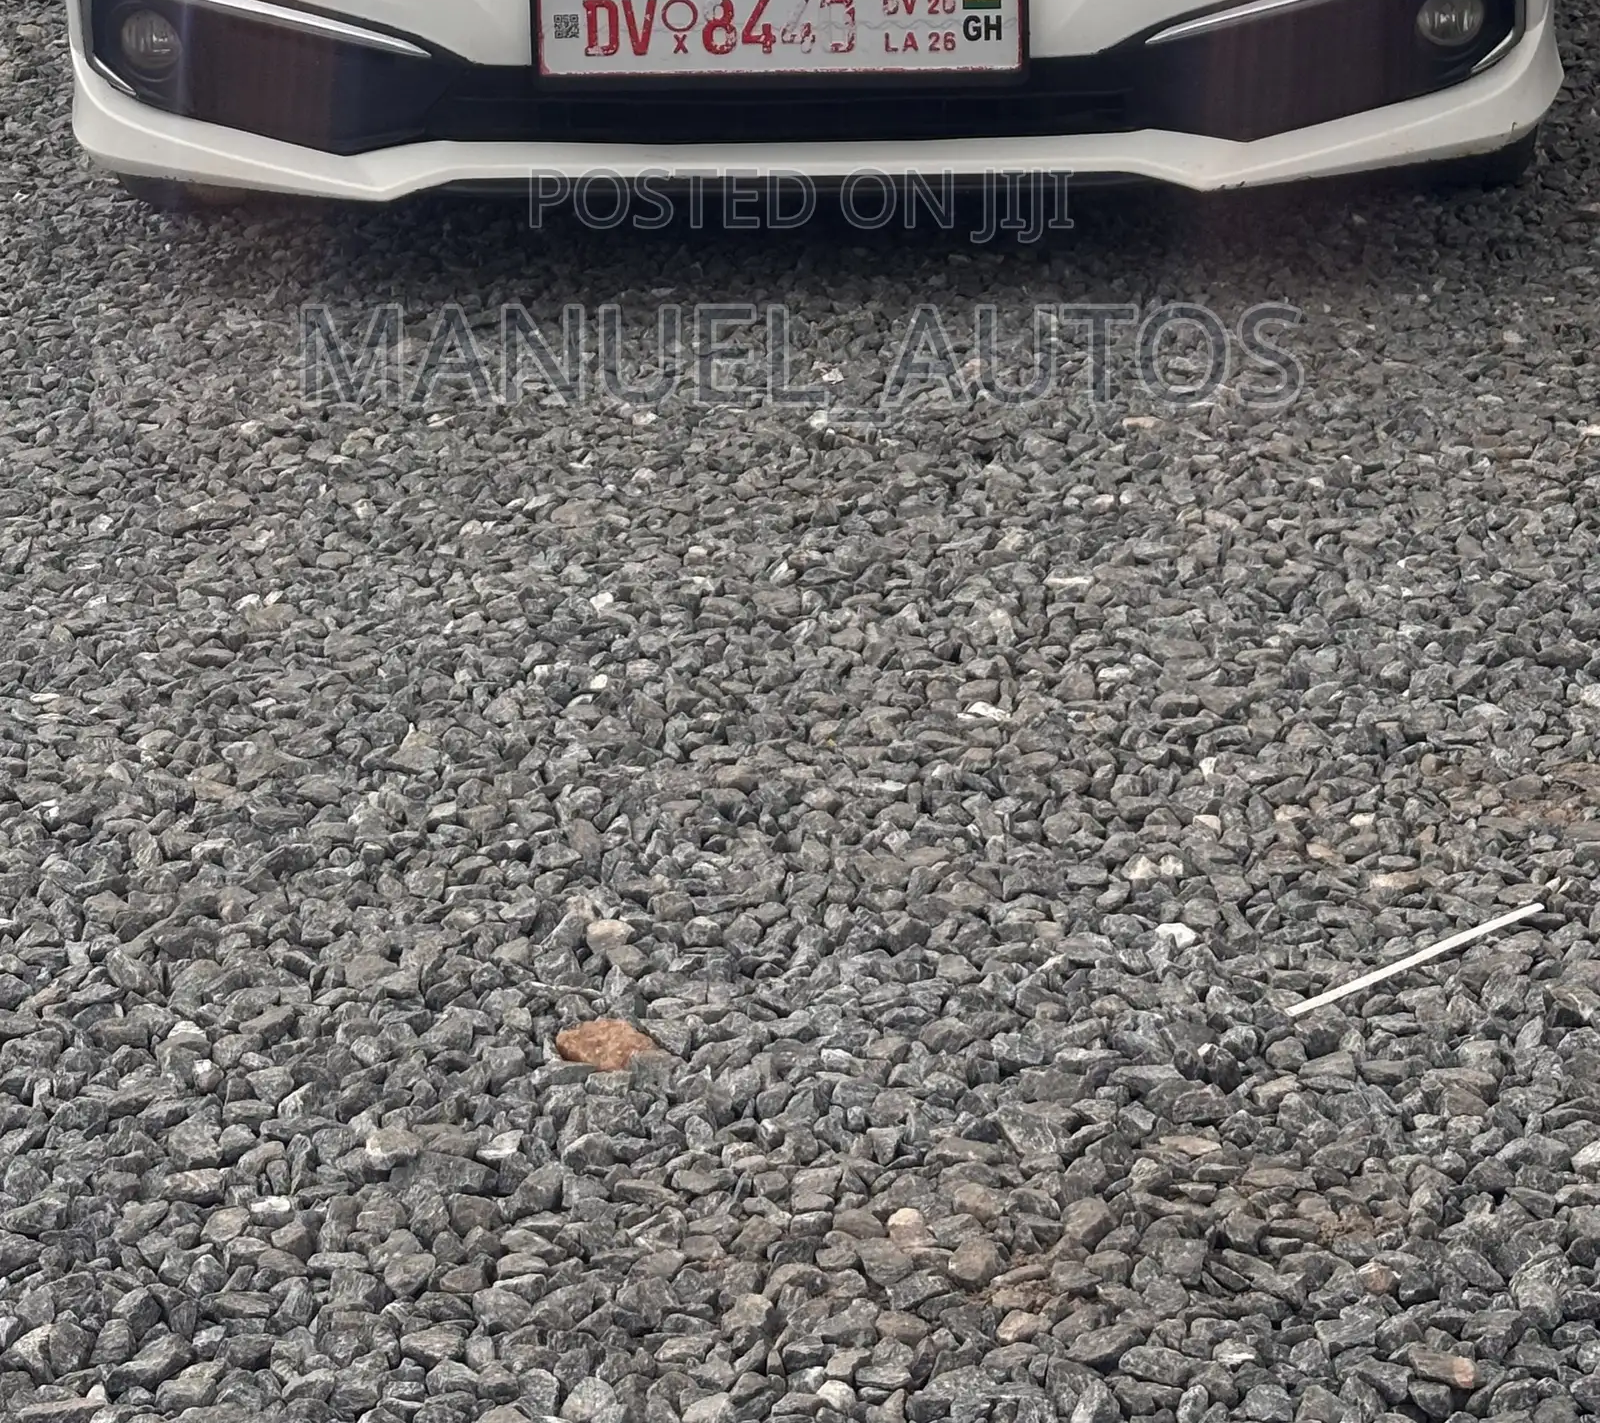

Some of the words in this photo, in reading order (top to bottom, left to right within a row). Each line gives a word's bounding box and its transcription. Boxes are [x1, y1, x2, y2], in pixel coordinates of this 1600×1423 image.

[962, 15, 1003, 41] GH
[883, 31, 919, 53] LA
[927, 31, 957, 53] 26
